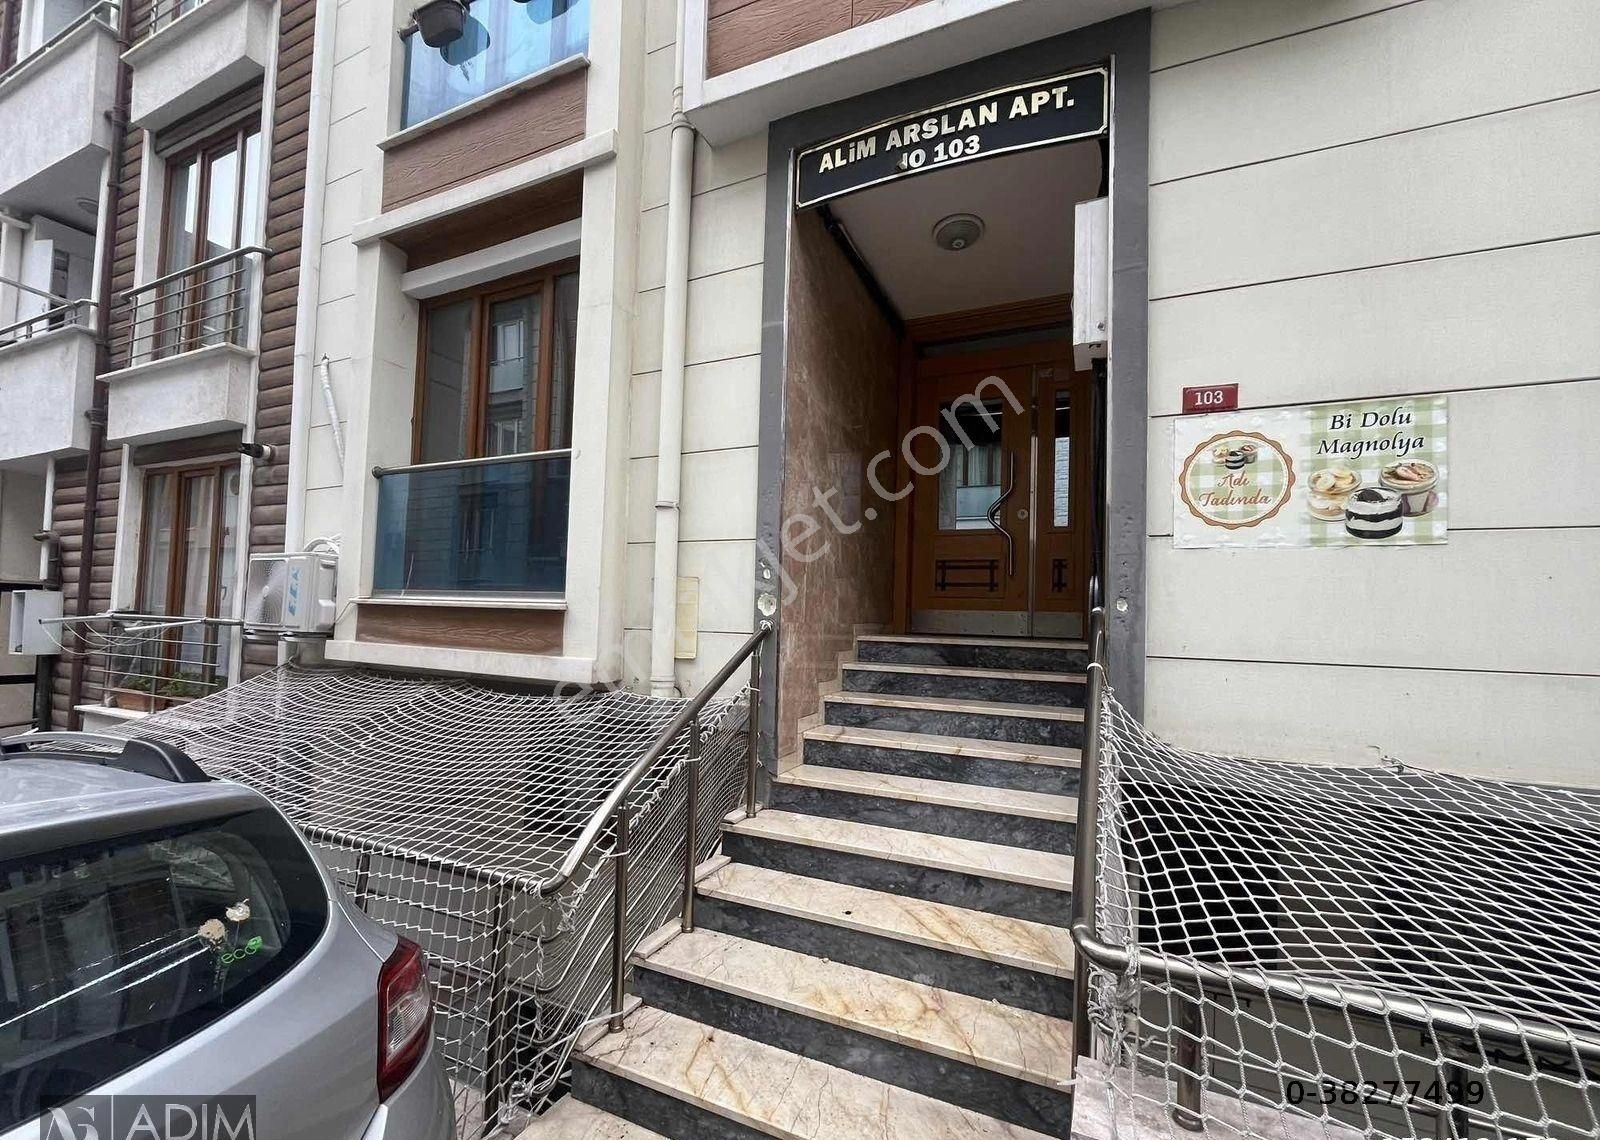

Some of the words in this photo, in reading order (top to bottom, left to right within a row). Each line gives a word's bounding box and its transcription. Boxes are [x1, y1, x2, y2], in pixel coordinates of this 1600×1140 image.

[885, 101, 998, 152] ARSLAN
[1008, 86, 1075, 120] APT.
[933, 135, 980, 163] 103
[1194, 390, 1224, 407] 103
[1330, 413, 1352, 430] Bi
[1360, 406, 1413, 428] Dolu
[1317, 431, 1425, 460] Magnolya
